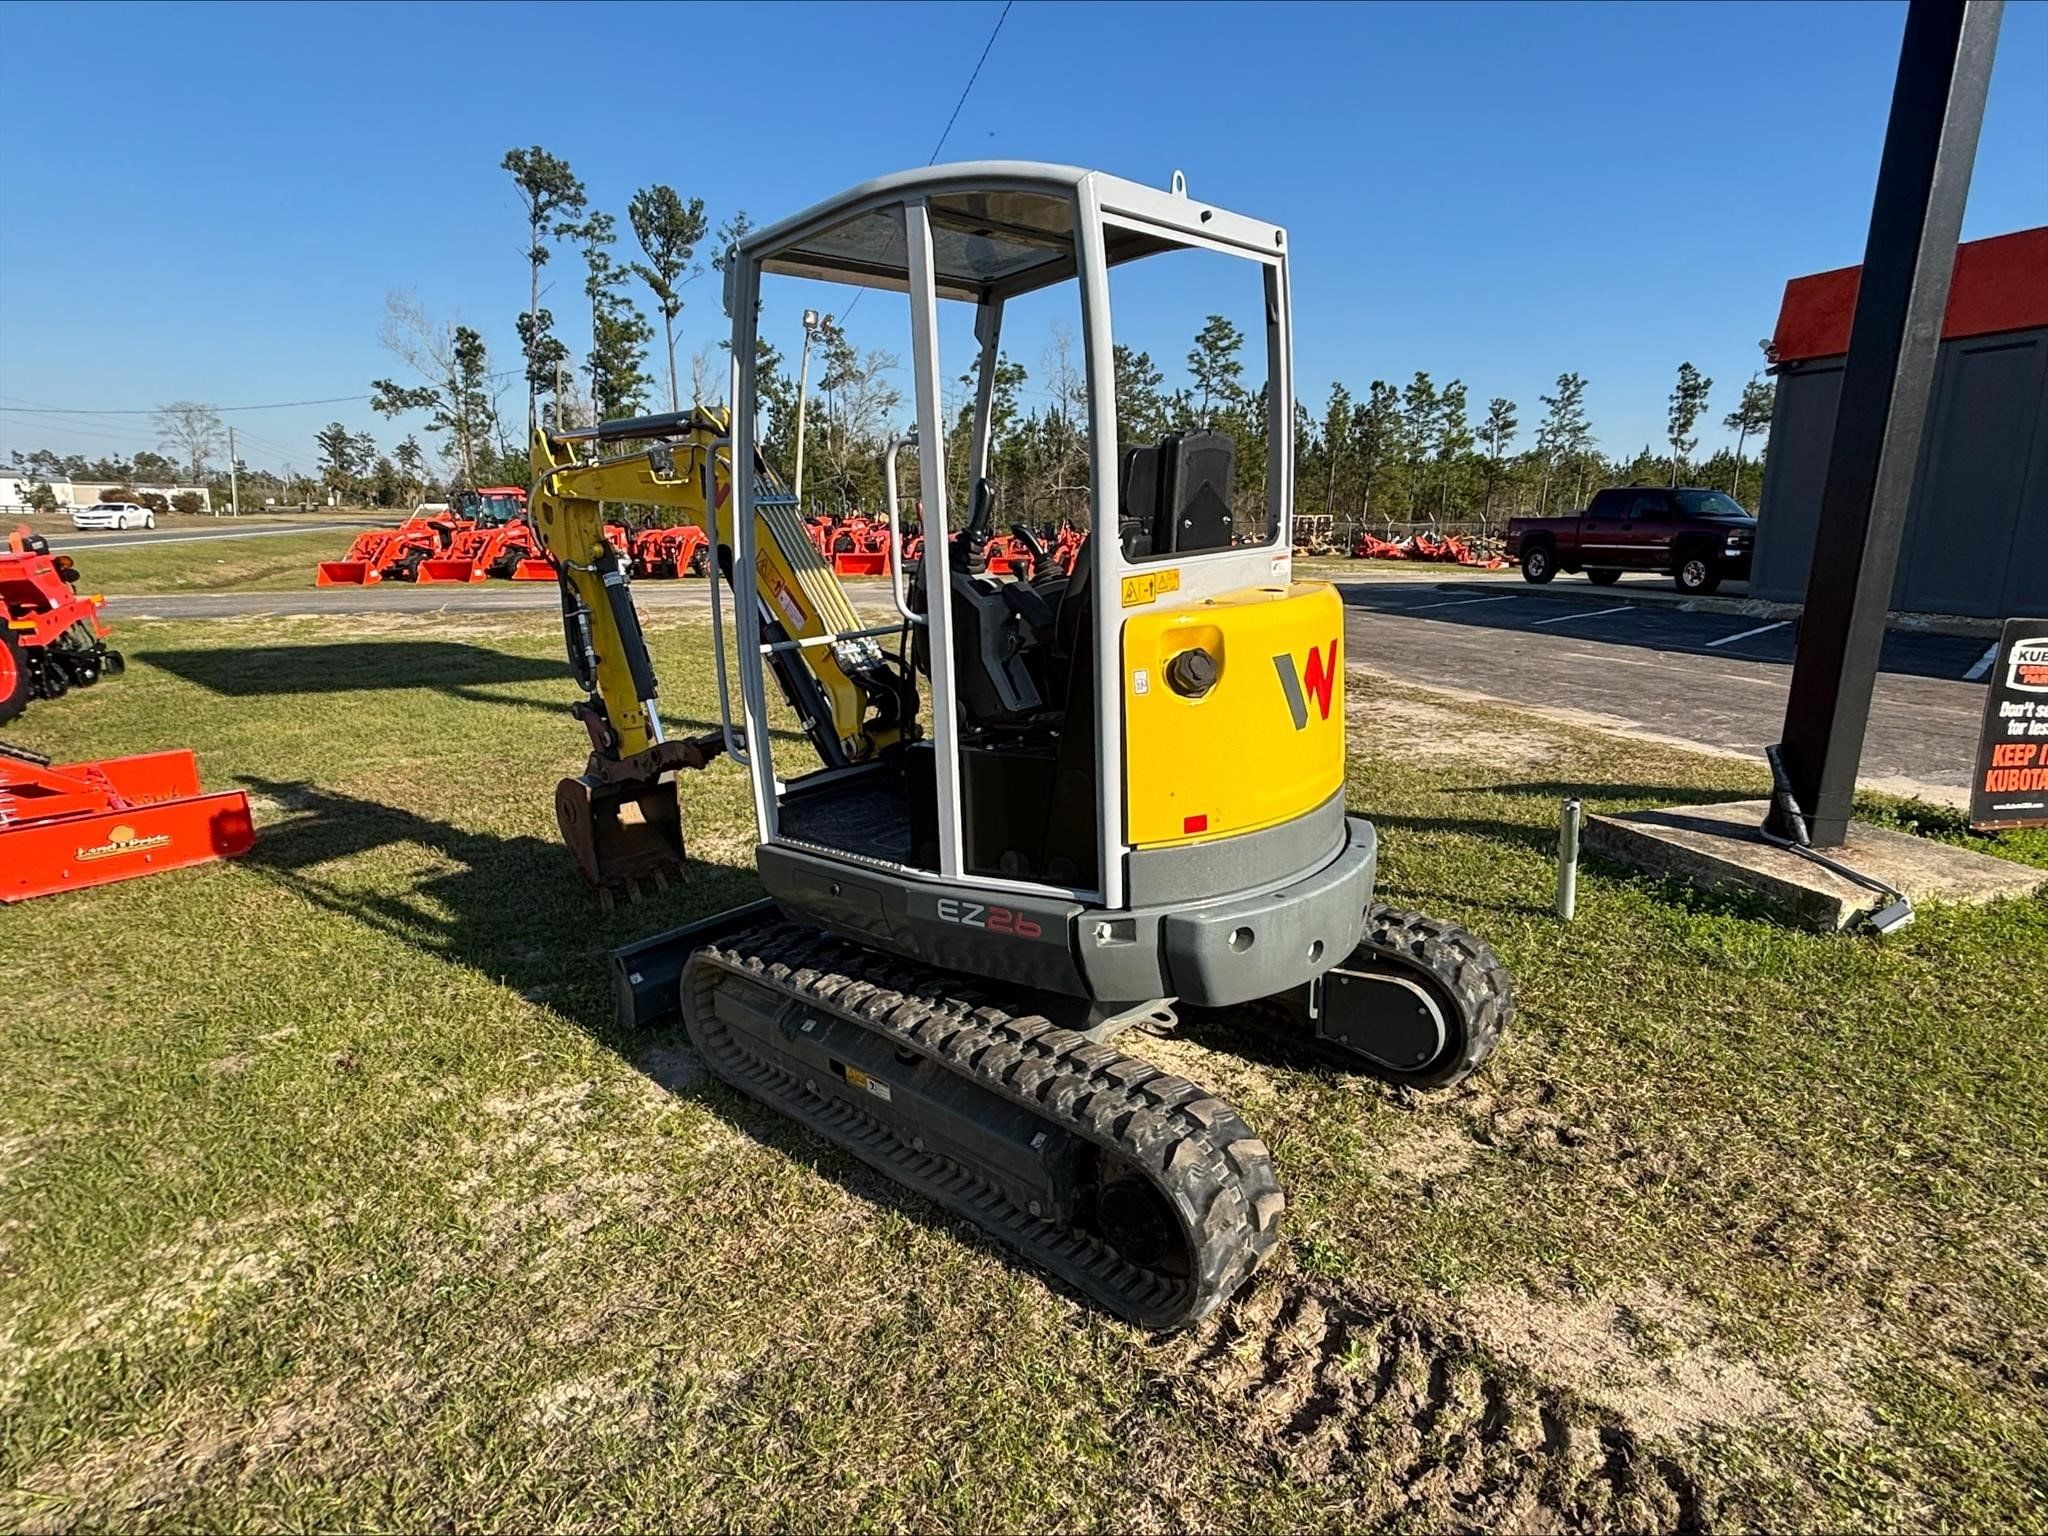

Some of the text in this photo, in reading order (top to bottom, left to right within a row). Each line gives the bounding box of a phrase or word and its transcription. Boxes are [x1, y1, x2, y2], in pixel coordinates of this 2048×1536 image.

[2000, 701, 2035, 718] Don't
[2008, 719, 2028, 735] for
[1992, 744, 2037, 767] KEEP
[1985, 769, 2048, 792] KUBOTA
[938, 898, 1042, 938] EZ26
